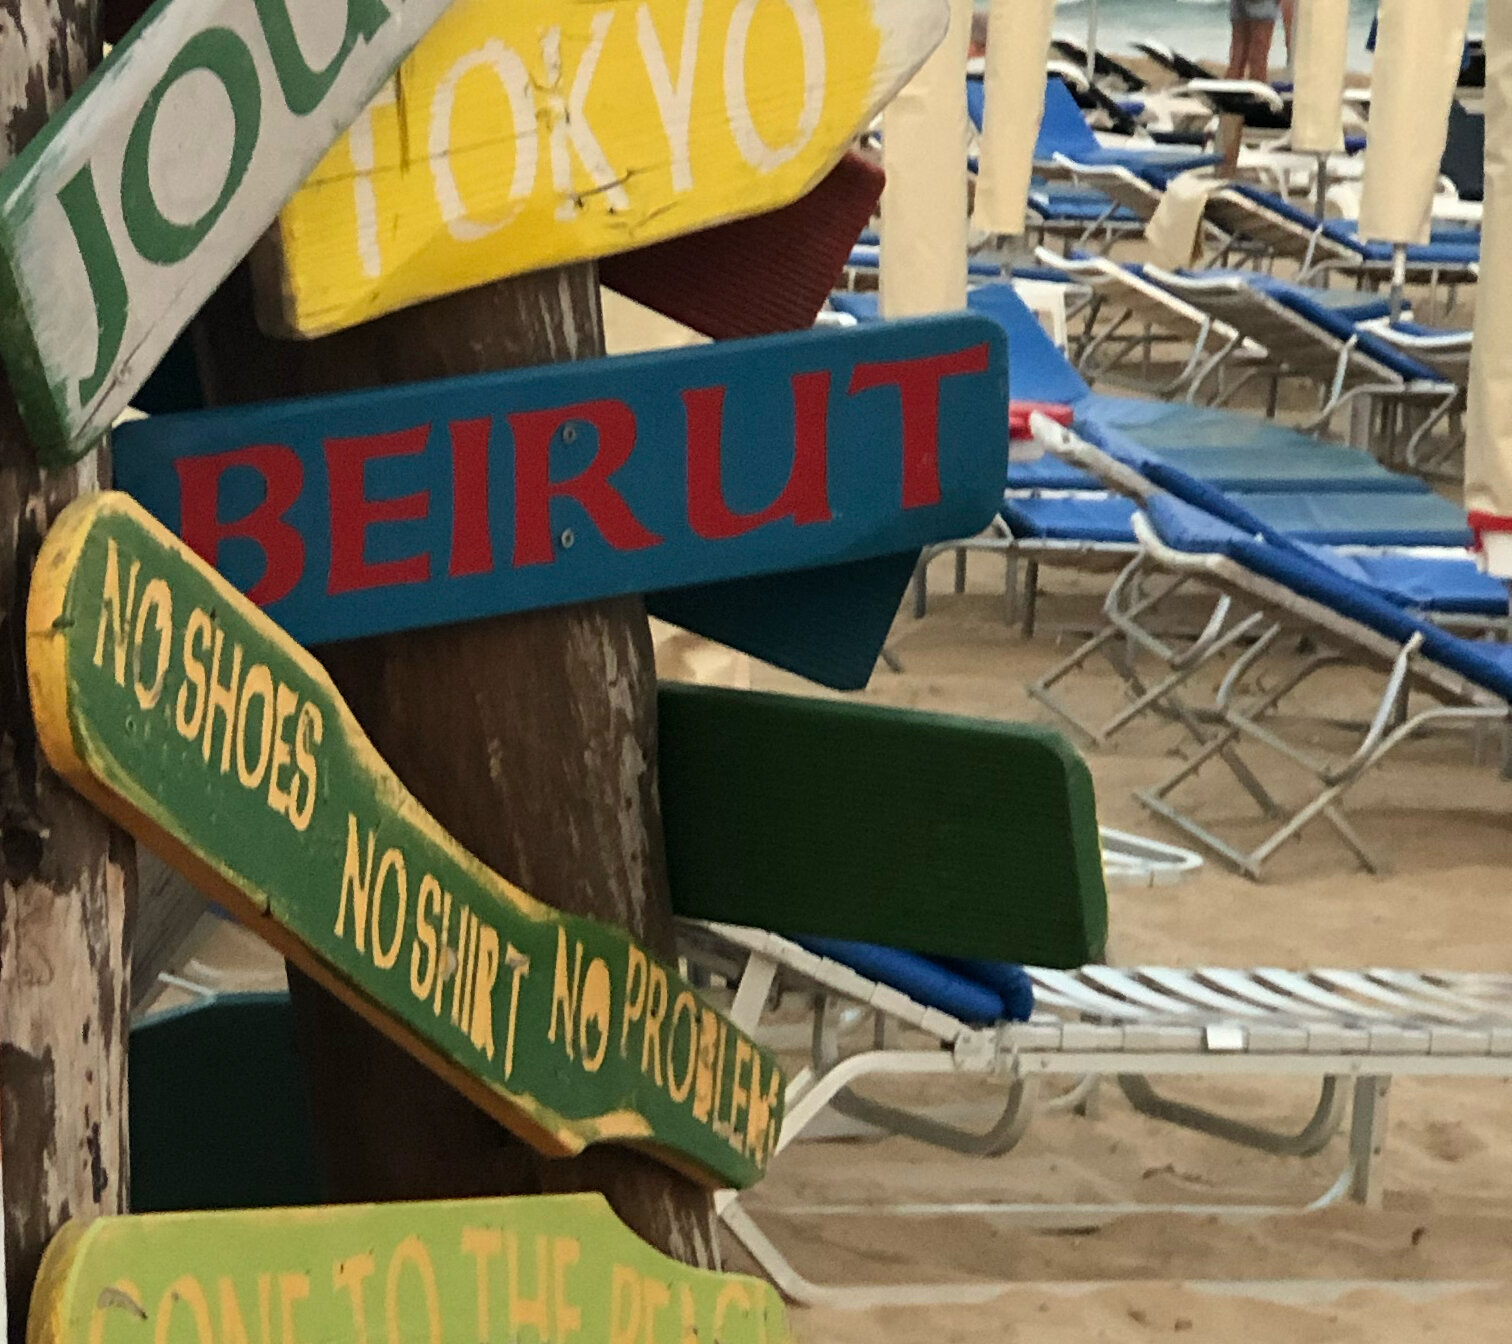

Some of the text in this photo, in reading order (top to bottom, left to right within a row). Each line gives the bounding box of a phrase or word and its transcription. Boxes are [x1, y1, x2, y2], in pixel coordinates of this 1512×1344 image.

[175, 343, 991, 607] BEIRUT
[94, 539, 780, 1170] NO SHOES NO SHIRT NO PROBLEM
